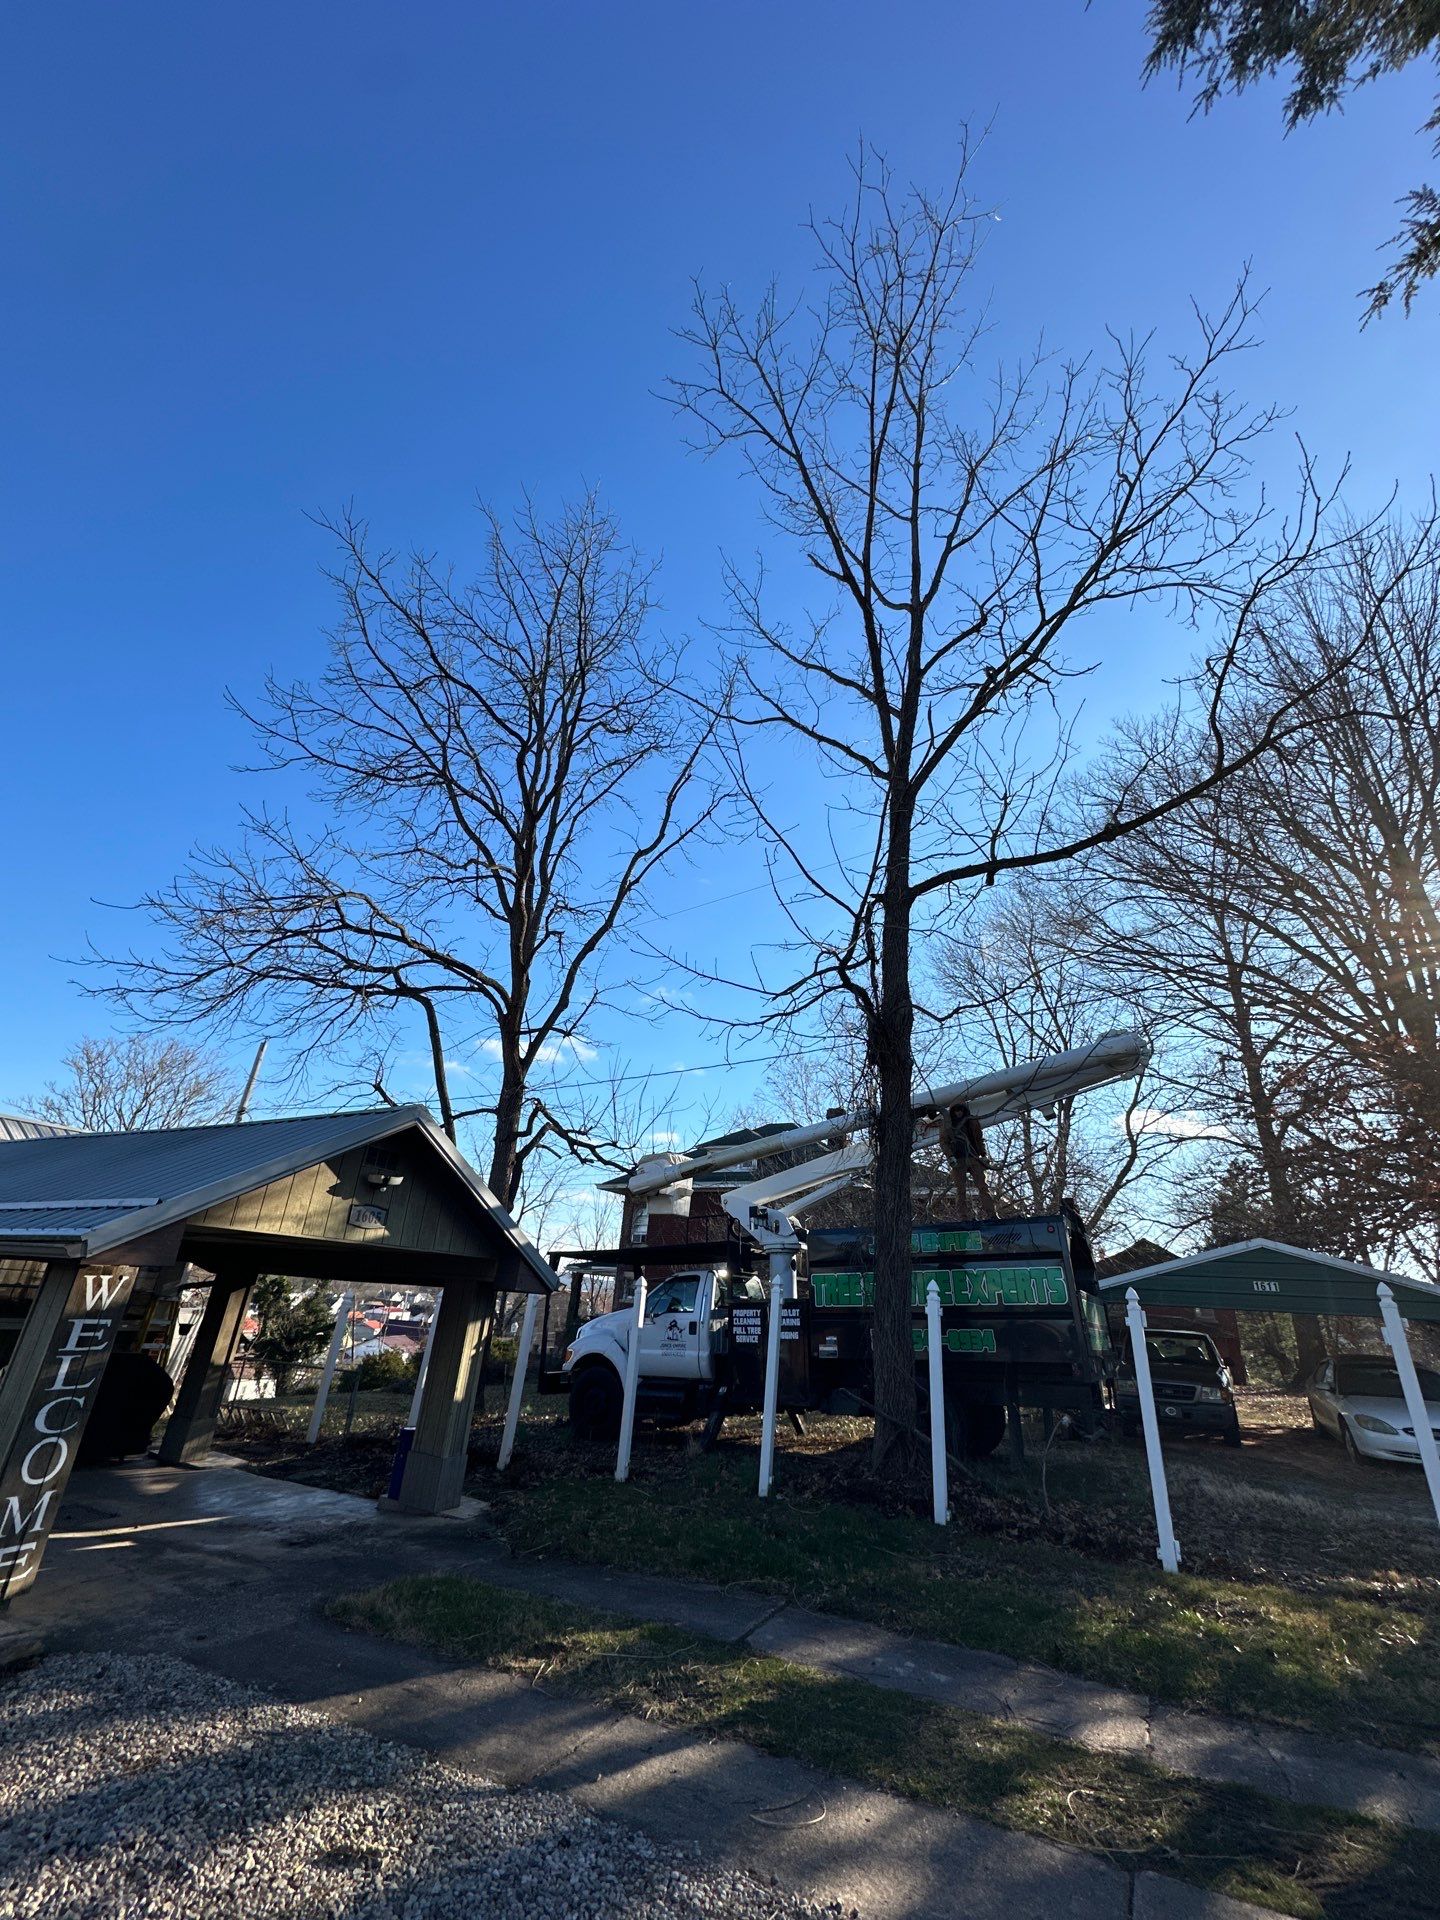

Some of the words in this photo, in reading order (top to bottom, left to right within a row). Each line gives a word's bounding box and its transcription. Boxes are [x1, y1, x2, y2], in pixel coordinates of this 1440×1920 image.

[921, 1231, 983, 1253] EMPIRE
[811, 1272, 864, 1307] TREE
[950, 1266, 1069, 1306] EXPERTS
[1253, 1281, 1280, 1292] 1611
[733, 1309, 761, 1317] PROPERTY
[733, 1317, 761, 1326] CLEANING
[747, 1326, 761, 1335] TREE
[736, 1335, 759, 1343] SERVICE
